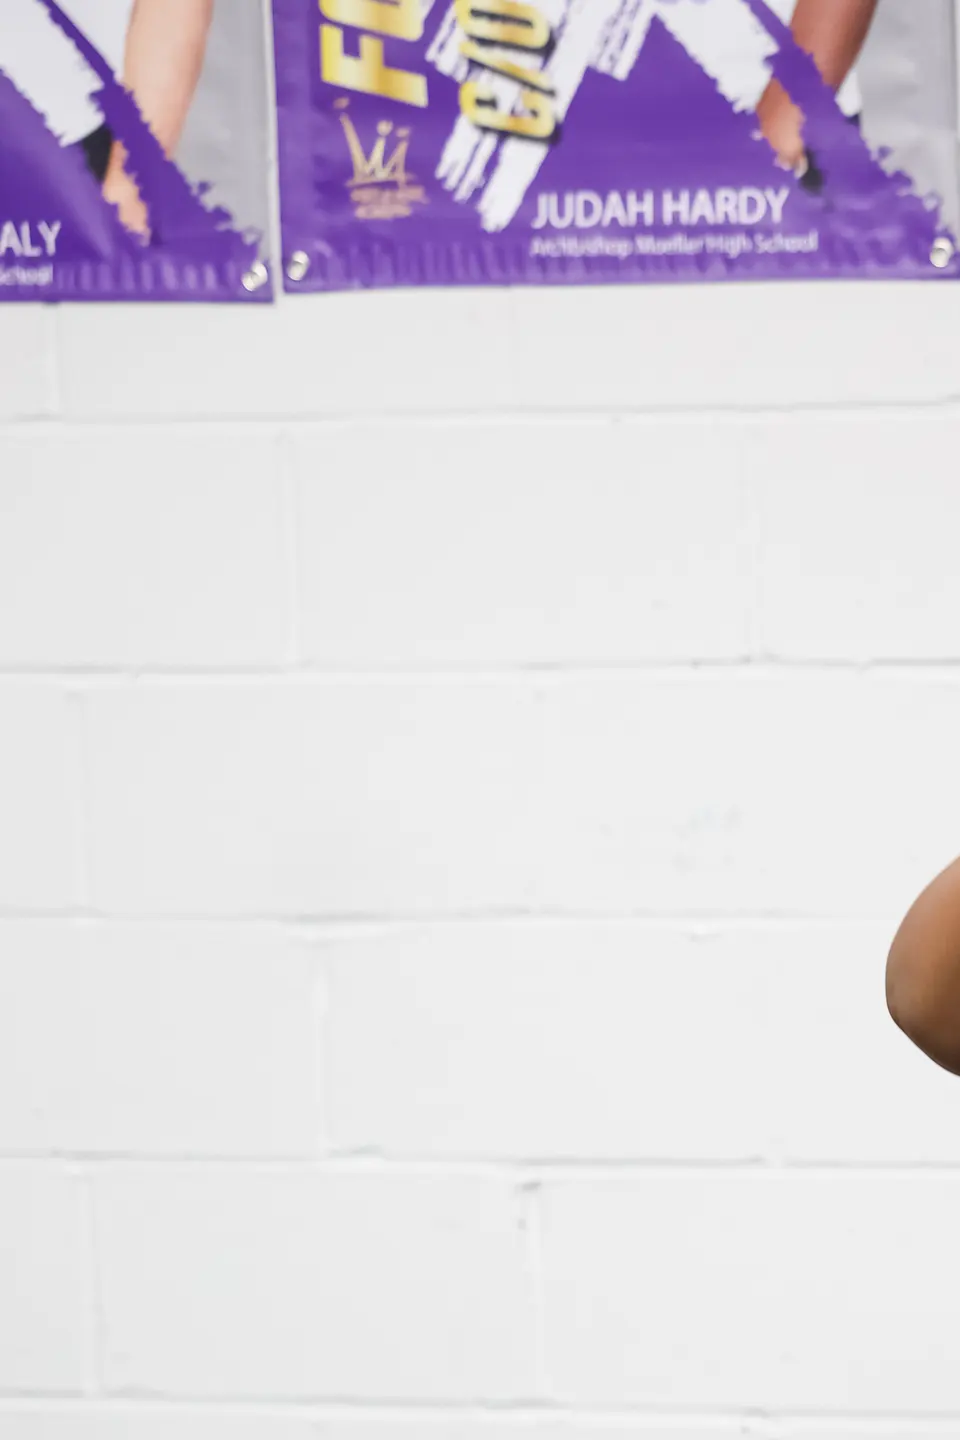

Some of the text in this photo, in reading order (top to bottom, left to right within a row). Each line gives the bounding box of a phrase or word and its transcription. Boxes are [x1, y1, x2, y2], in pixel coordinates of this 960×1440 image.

[530, 185, 790, 230] JUDAH HARDY
[705, 232, 753, 259] High
[754, 228, 819, 253] School
[0, 262, 54, 287] chool
